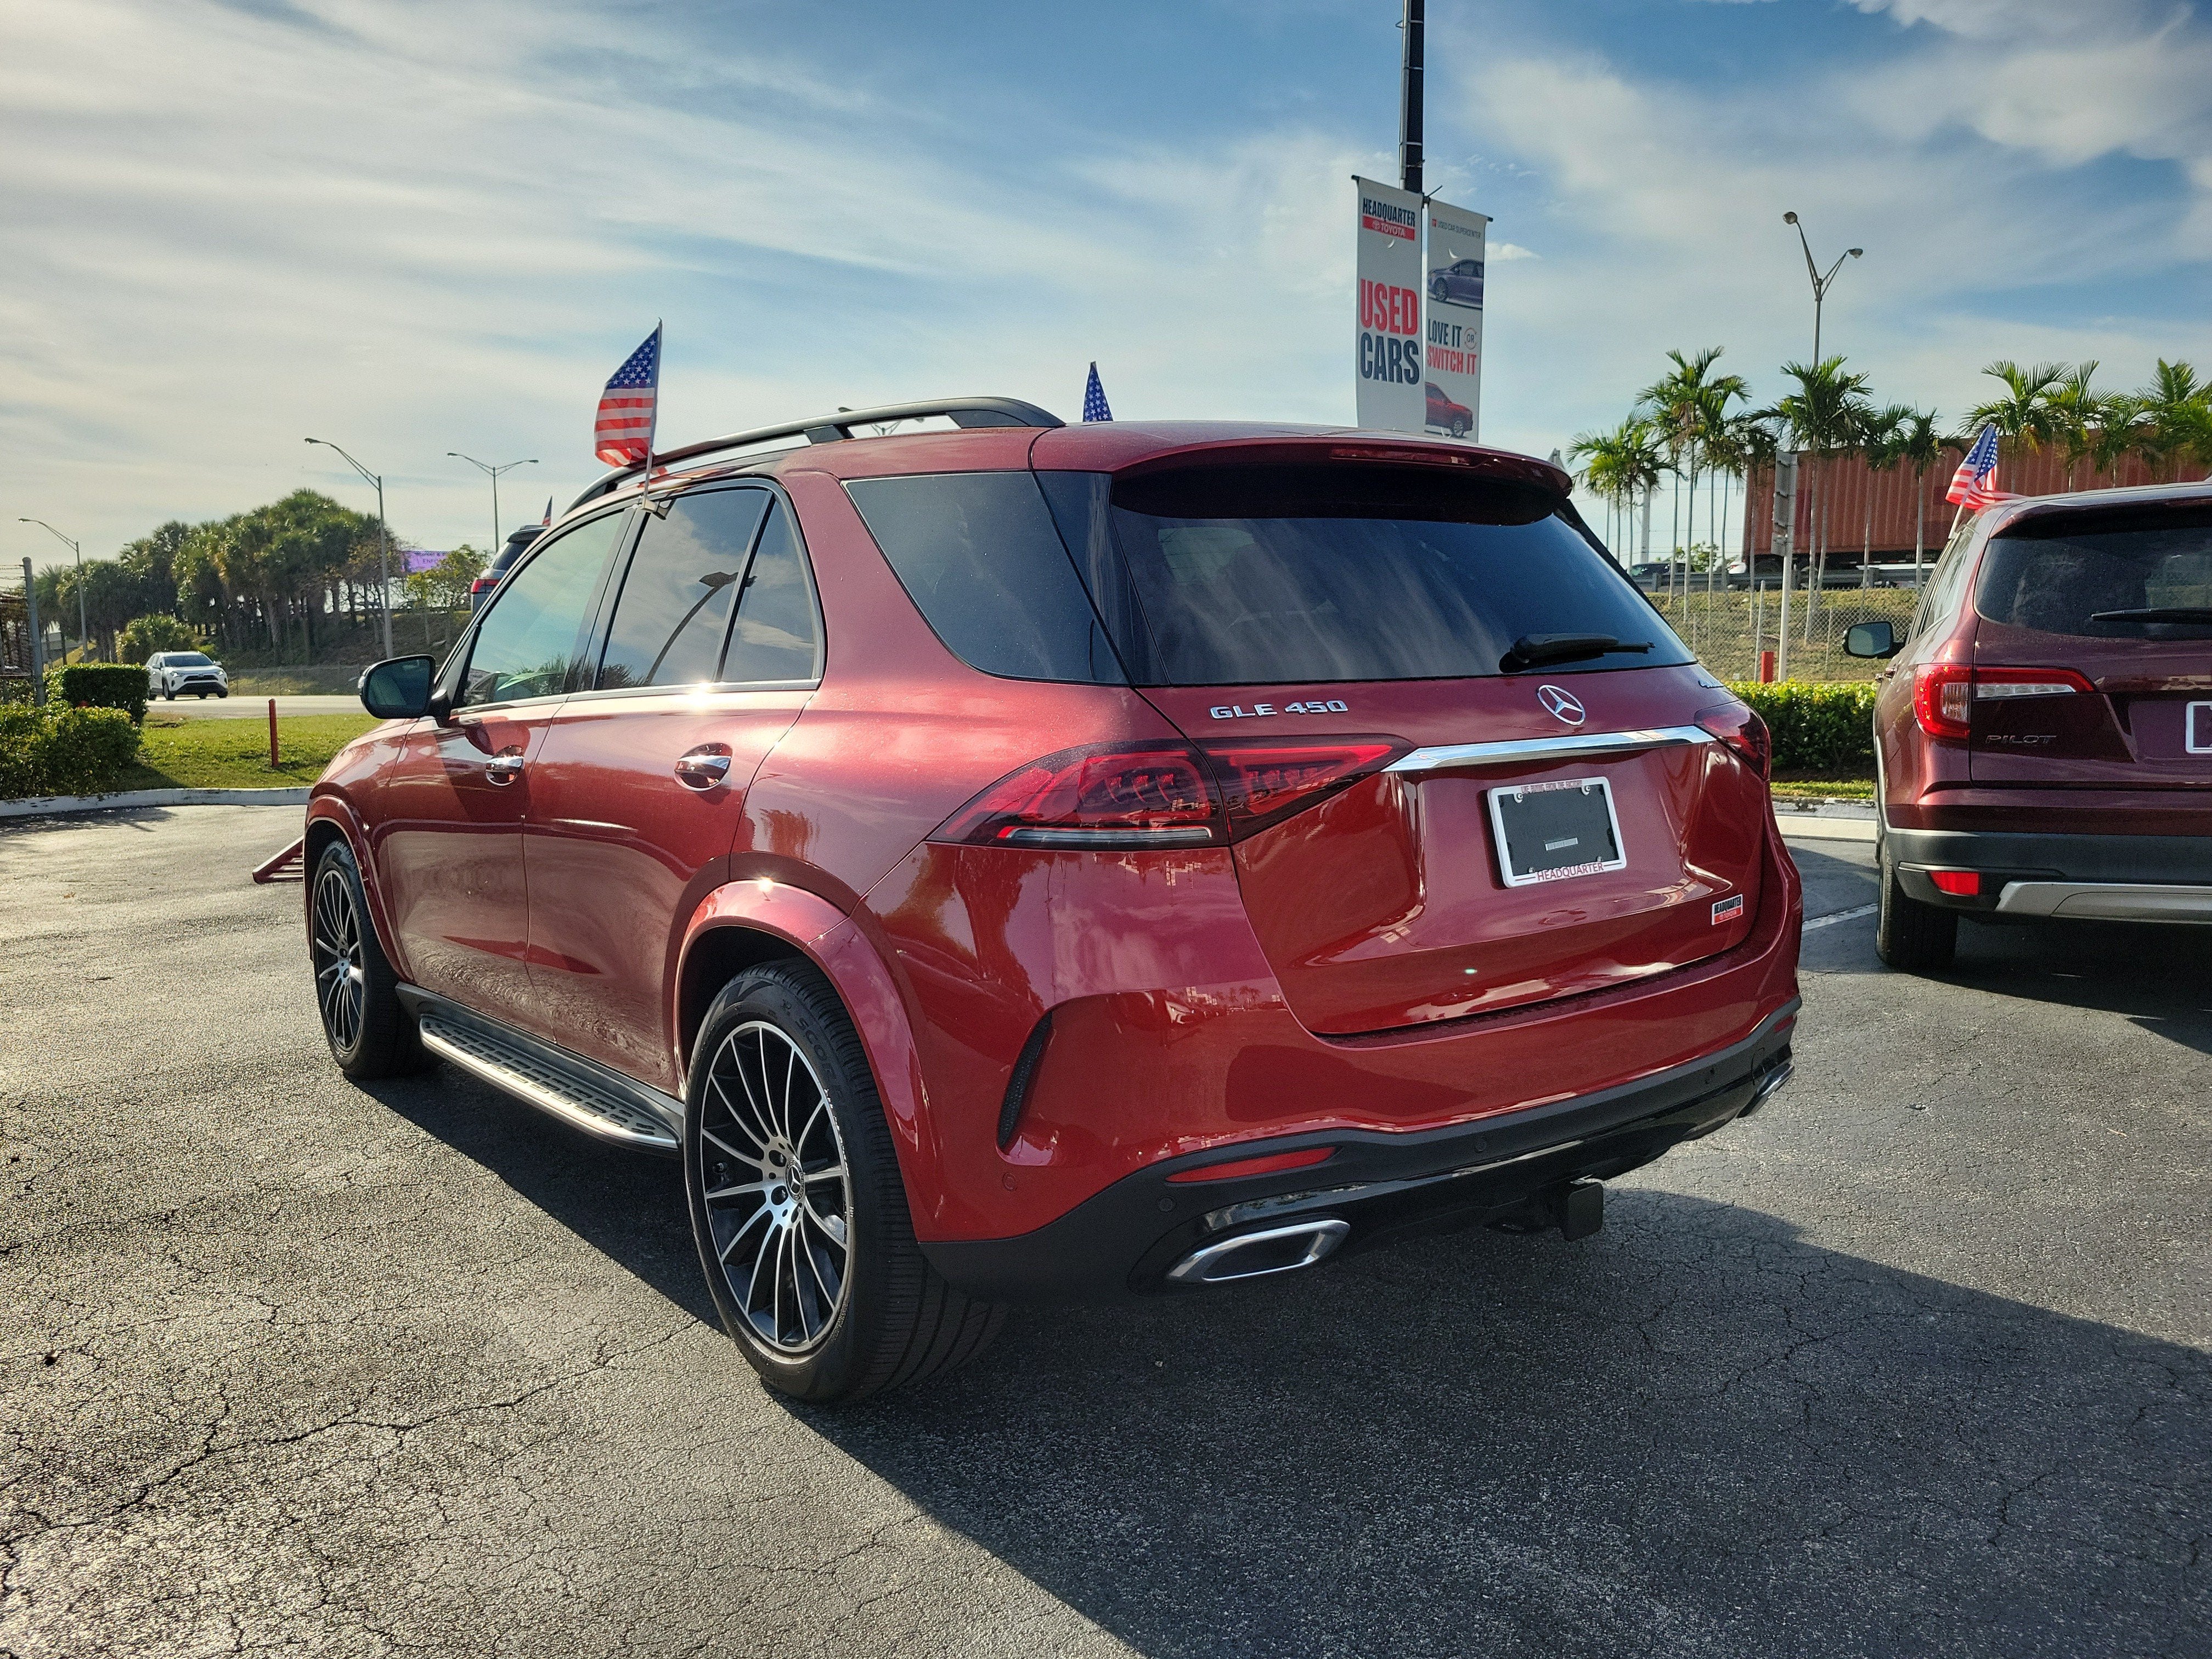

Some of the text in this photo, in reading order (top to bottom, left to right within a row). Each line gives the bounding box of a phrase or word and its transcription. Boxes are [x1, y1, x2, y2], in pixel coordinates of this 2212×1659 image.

[1363, 198, 1415, 227] HEADQUARTER
[1381, 222, 1405, 236] TOYOTA
[1360, 278, 1418, 336] USED
[1427, 319, 1475, 348] LOVE IT OR
[1360, 332, 1419, 385] CARS
[1427, 345, 1477, 375] SWITCH IT
[1210, 700, 1348, 719] GLE 450
[1985, 735, 2057, 743] PILOT
[1537, 863, 1604, 881] HEADQUARTER
